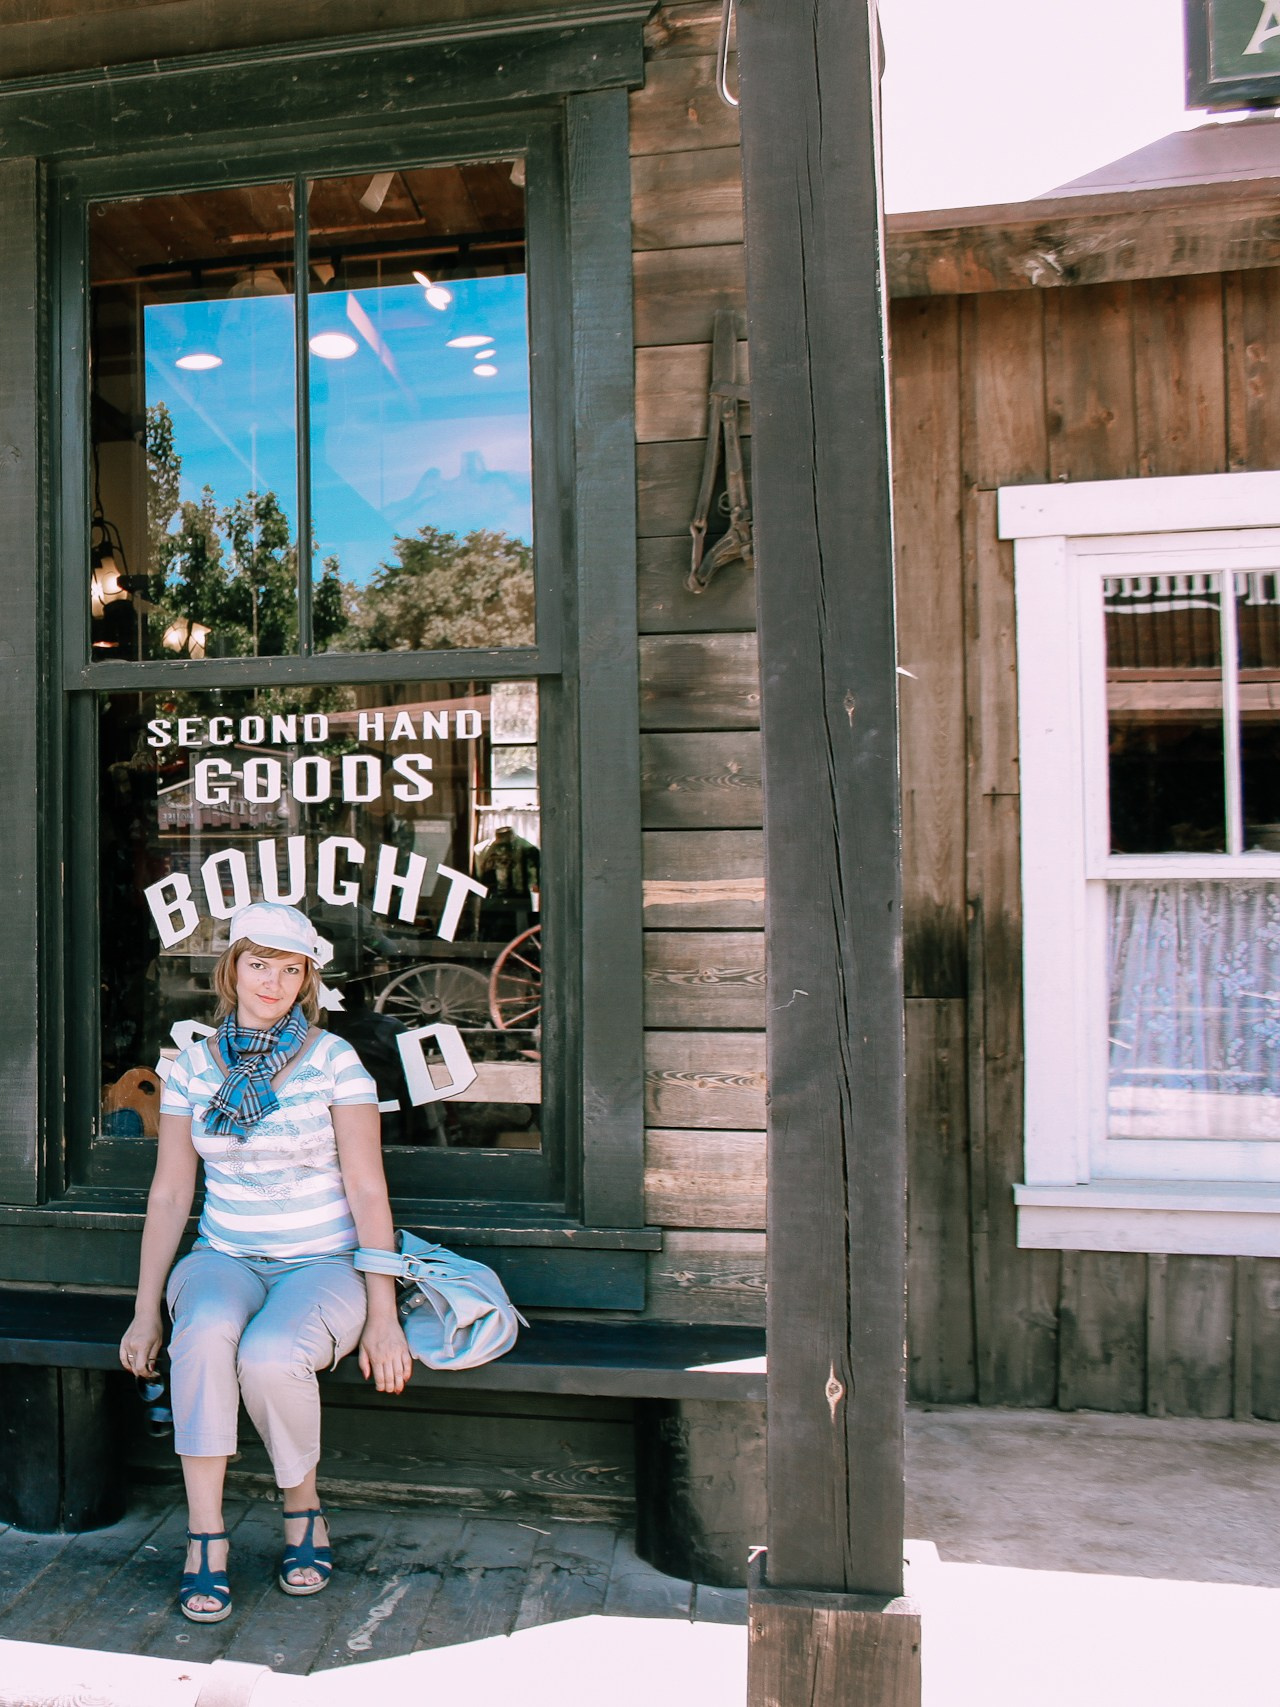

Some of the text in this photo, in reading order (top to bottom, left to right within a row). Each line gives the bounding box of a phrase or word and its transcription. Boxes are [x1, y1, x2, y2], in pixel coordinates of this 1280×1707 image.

[147, 709, 483, 748] SECOND HAND
[195, 753, 433, 804] GOODS
[143, 835, 488, 950] BOUGHT
